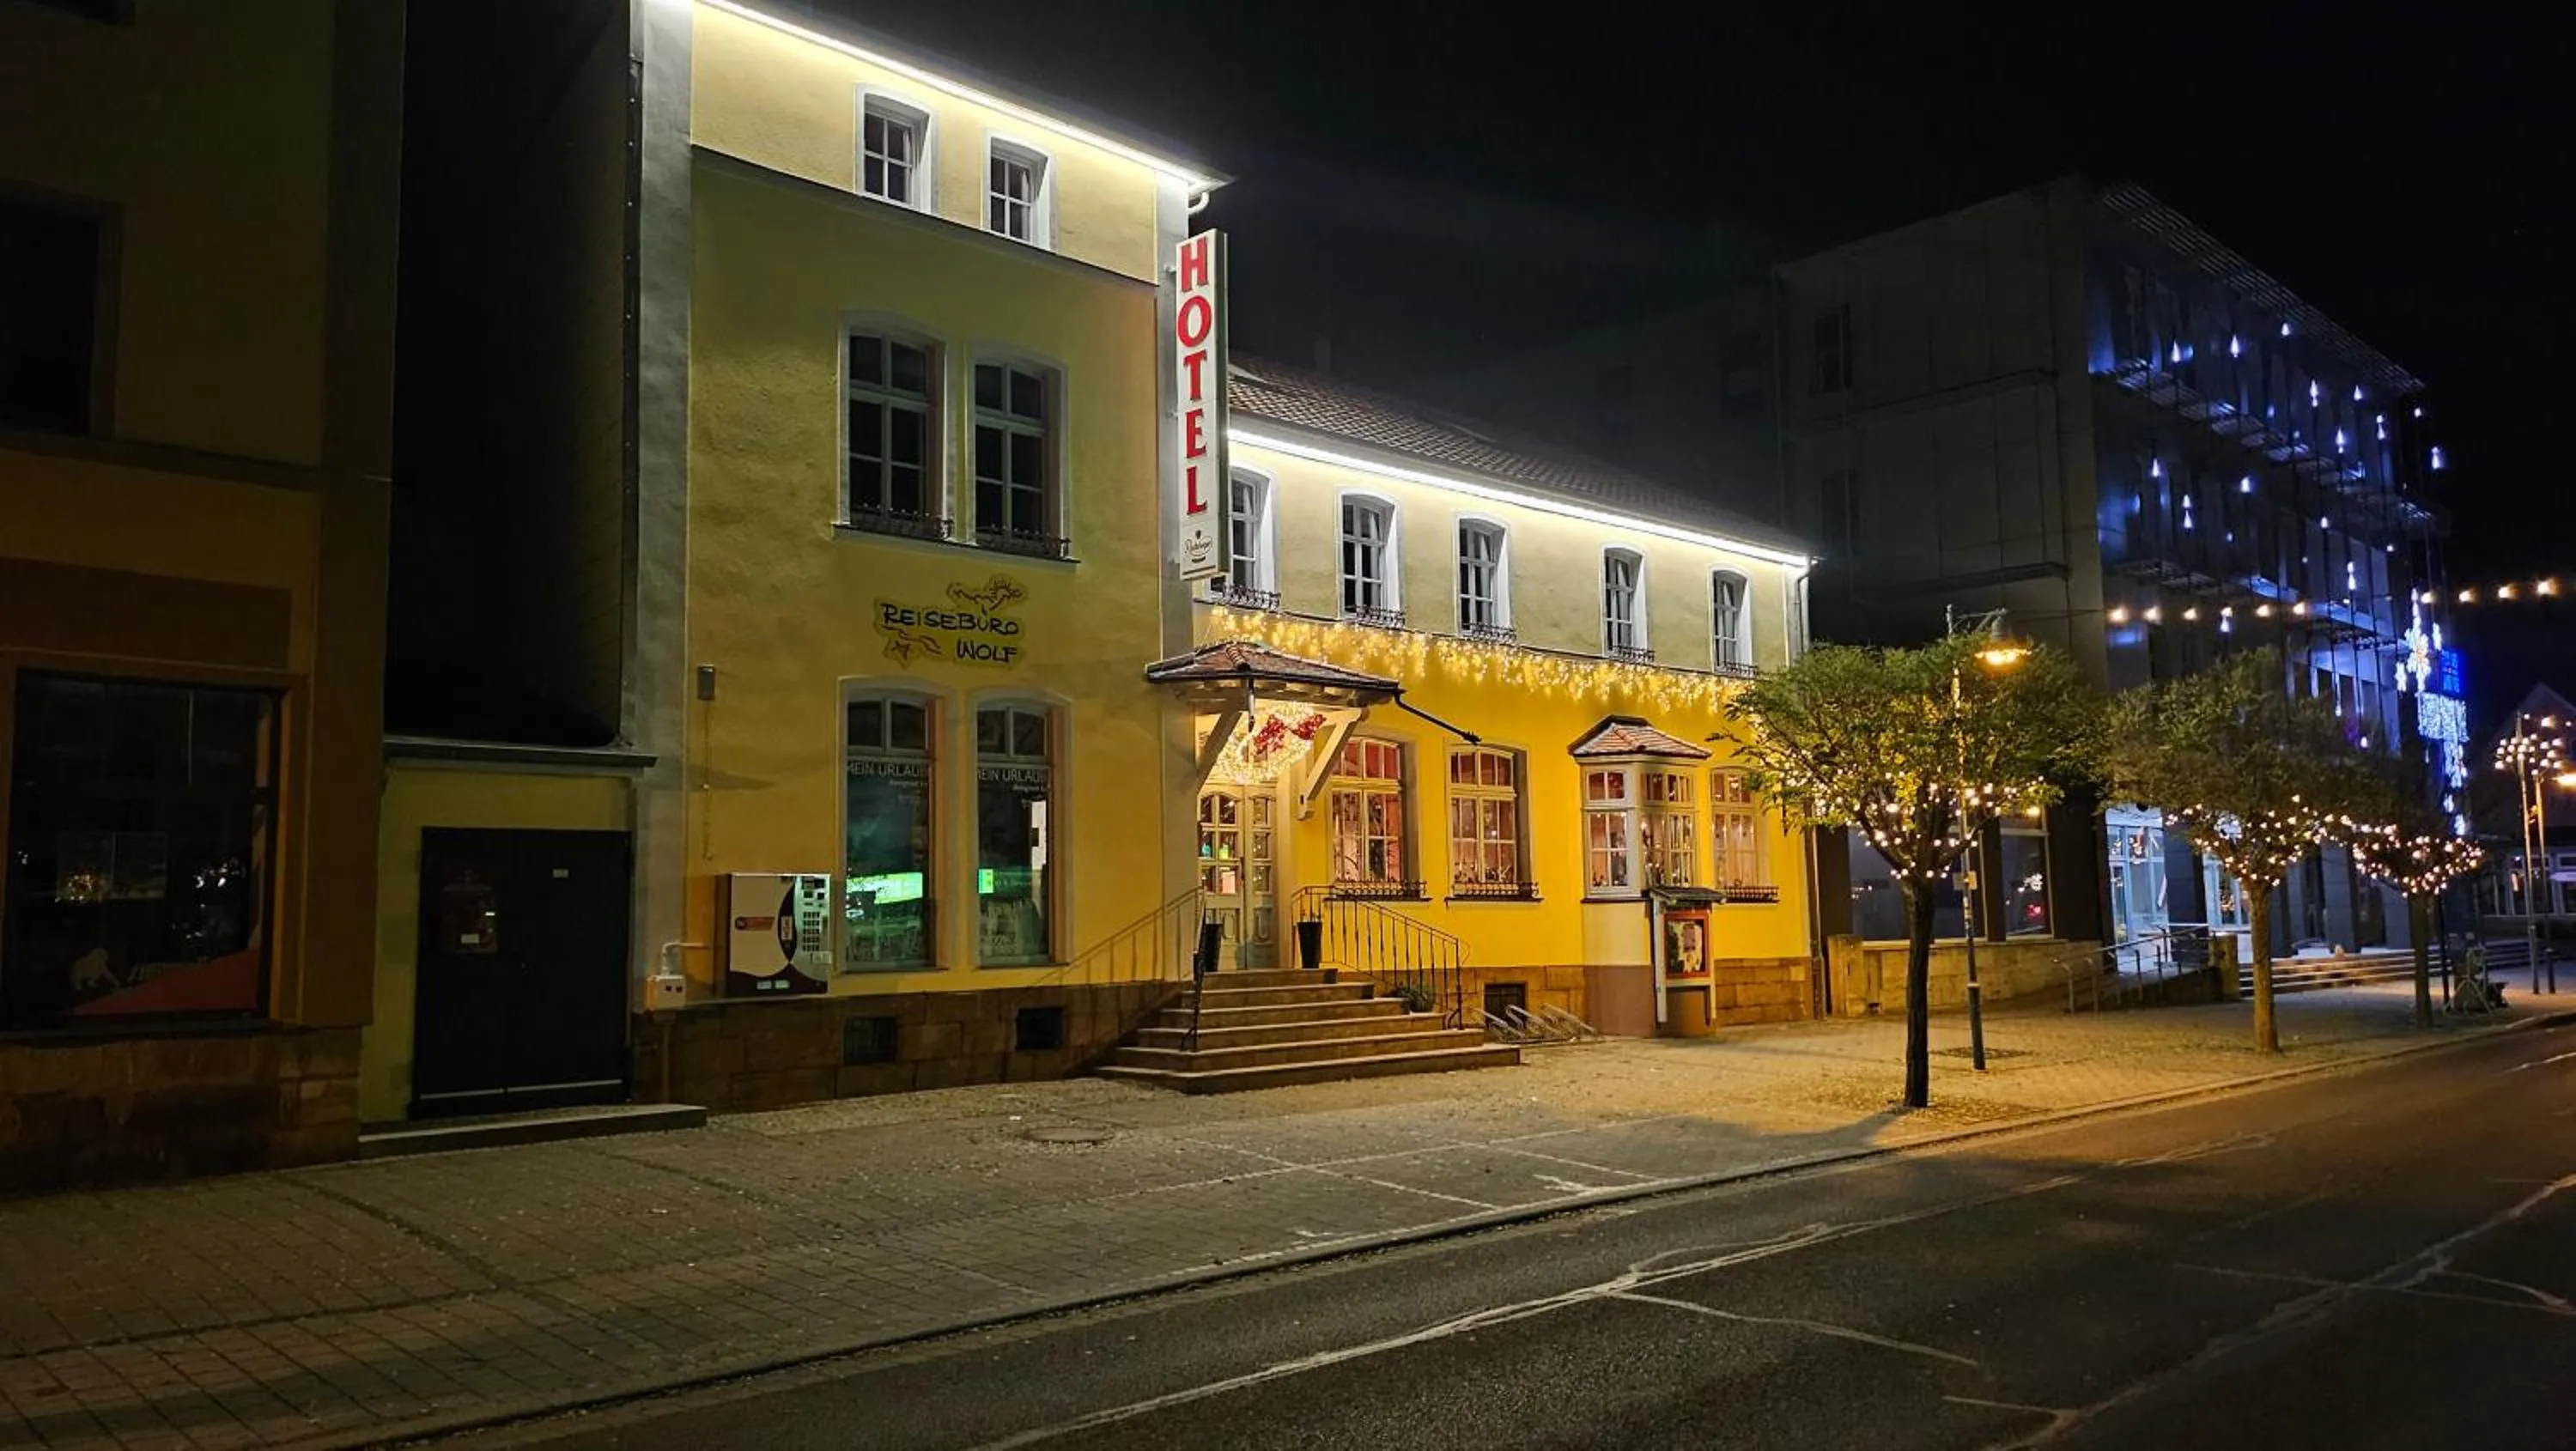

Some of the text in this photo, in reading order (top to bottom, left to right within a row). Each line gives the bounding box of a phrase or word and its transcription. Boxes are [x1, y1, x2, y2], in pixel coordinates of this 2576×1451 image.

[1176, 235, 1213, 516] HOTEL
[880, 603, 1020, 635] REISEBÜRO
[957, 639, 1018, 663] WOLF
